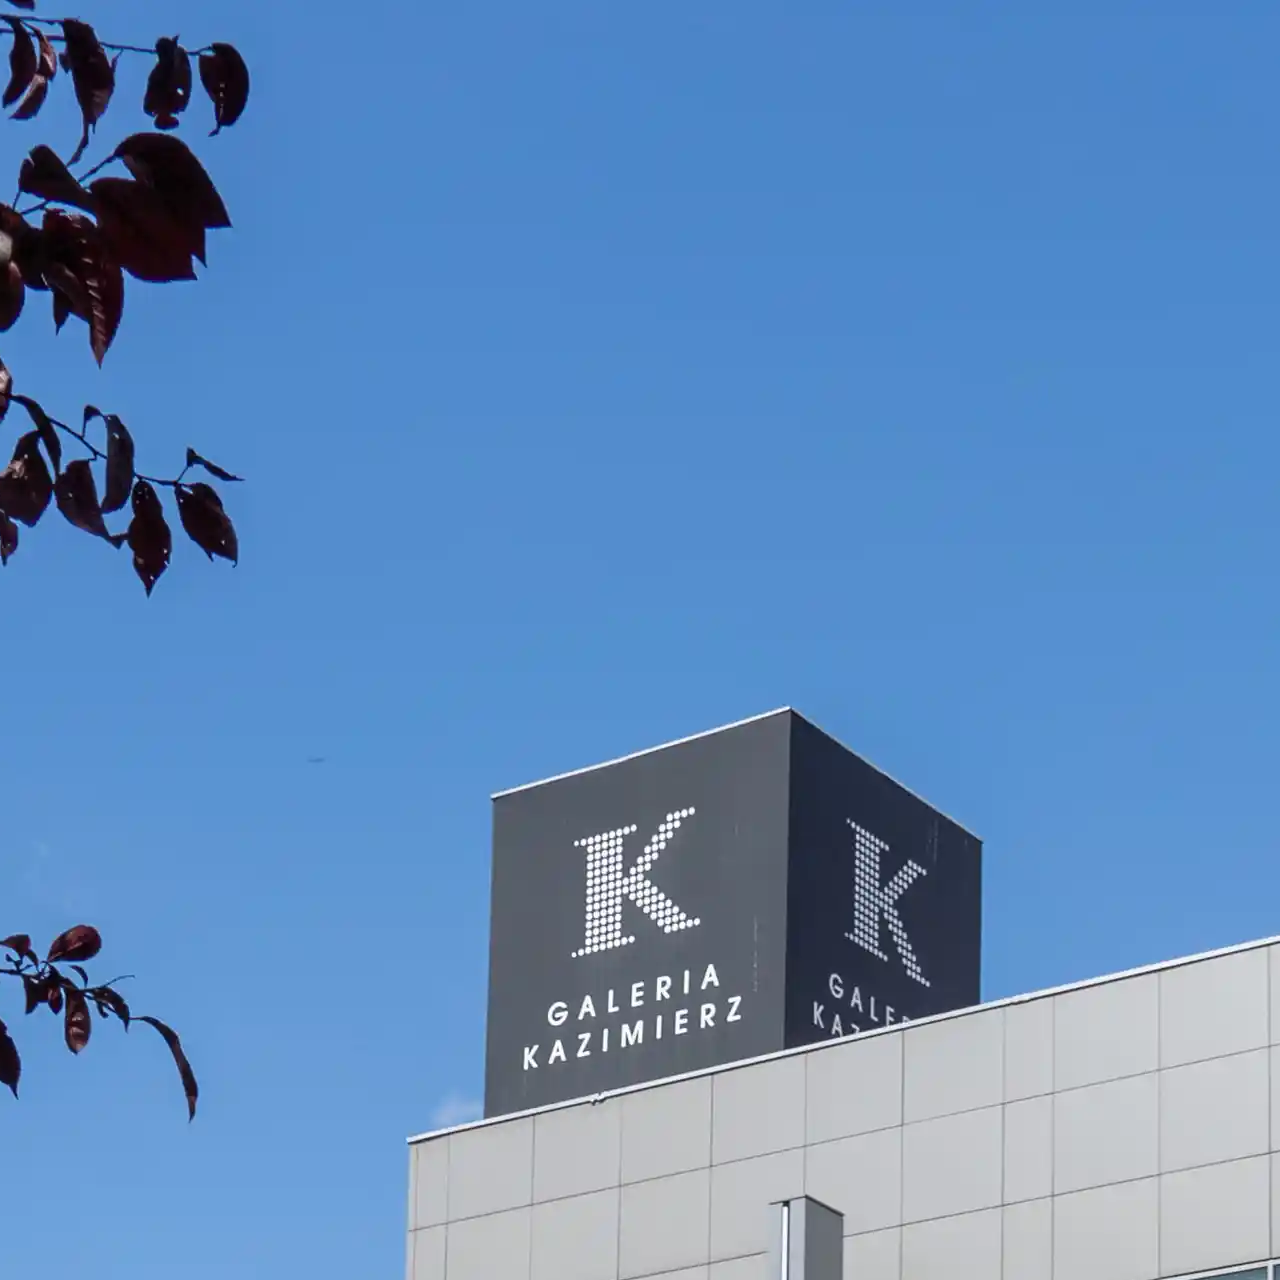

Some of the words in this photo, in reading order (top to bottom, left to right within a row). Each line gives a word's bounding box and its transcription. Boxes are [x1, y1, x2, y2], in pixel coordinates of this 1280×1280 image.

[570, 806, 701, 958] K
[844, 817, 931, 988] K
[522, 995, 743, 1071] KAZIMIERZ
[547, 963, 721, 1028] GALERIA
